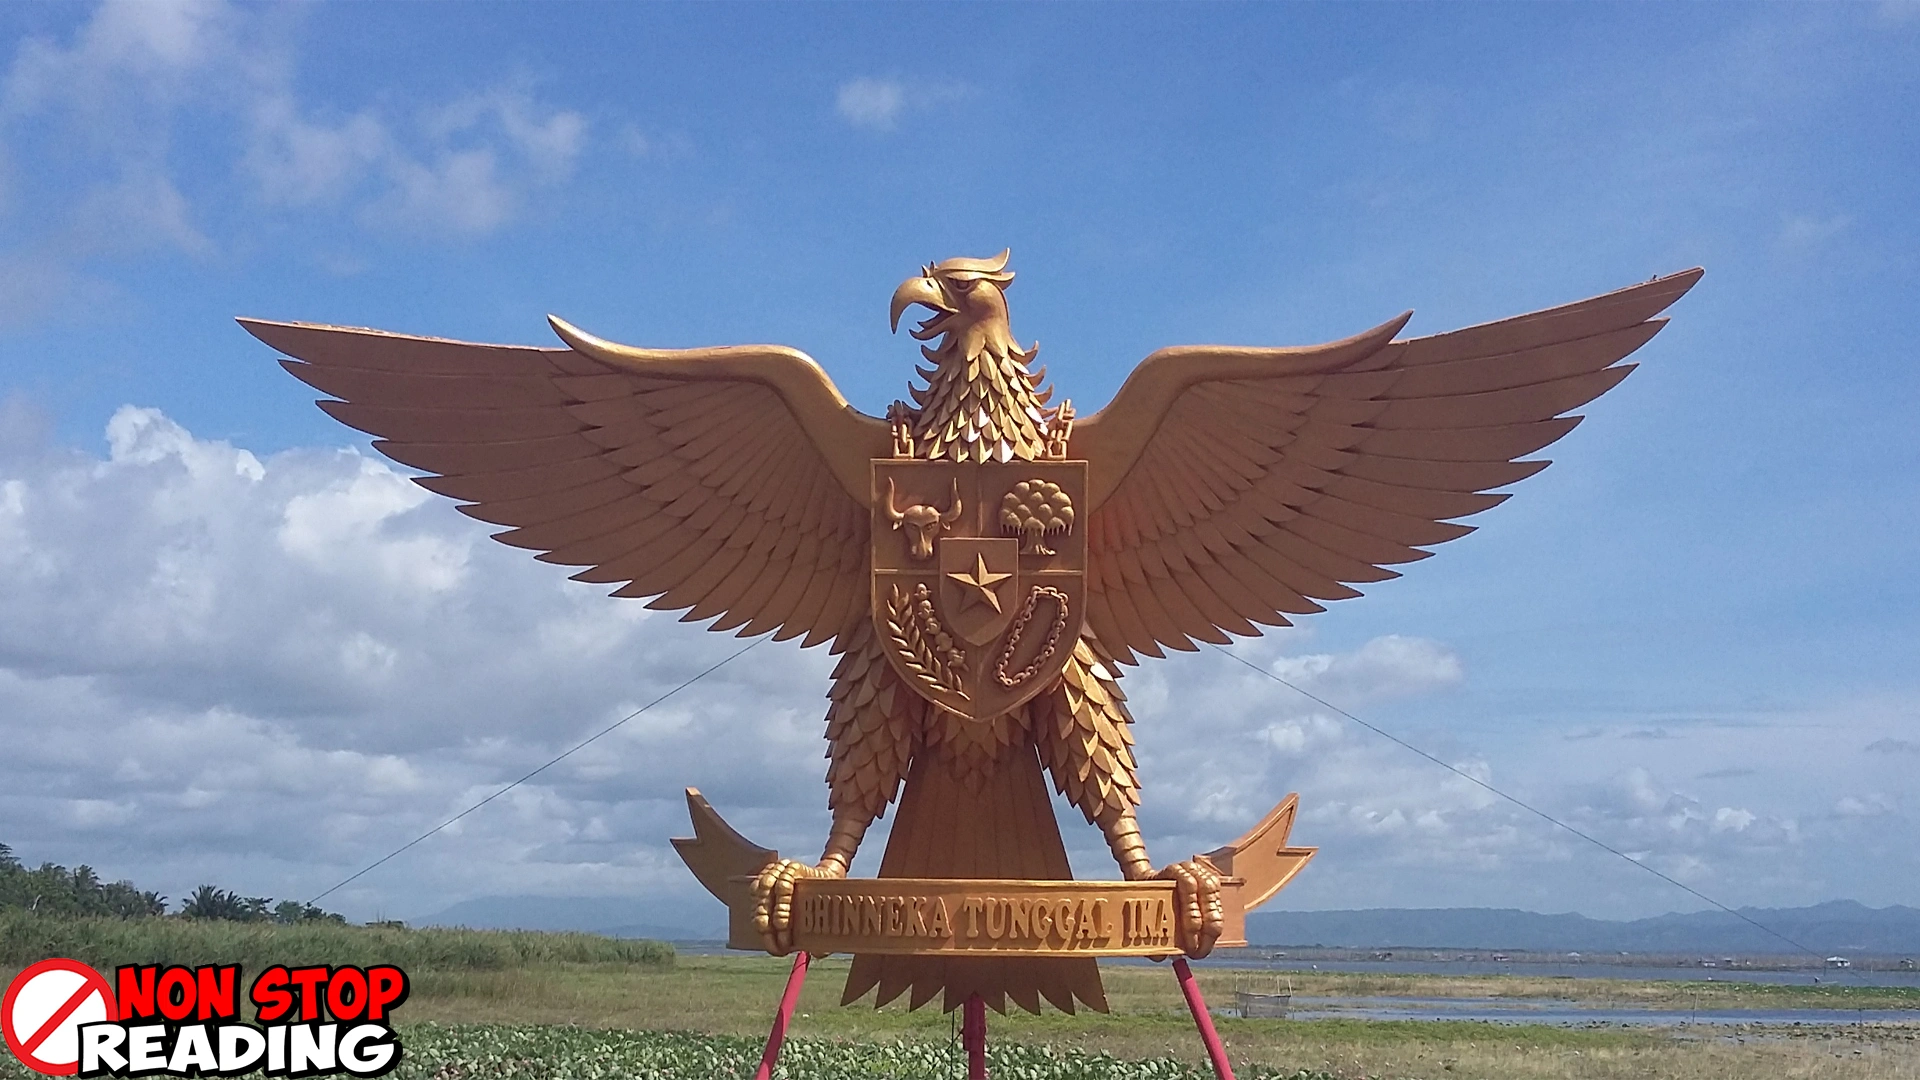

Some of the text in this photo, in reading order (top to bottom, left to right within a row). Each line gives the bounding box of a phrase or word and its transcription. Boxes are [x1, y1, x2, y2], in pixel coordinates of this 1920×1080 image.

[803, 895, 1172, 940] BHINNEKA TUNGGAL IKA
